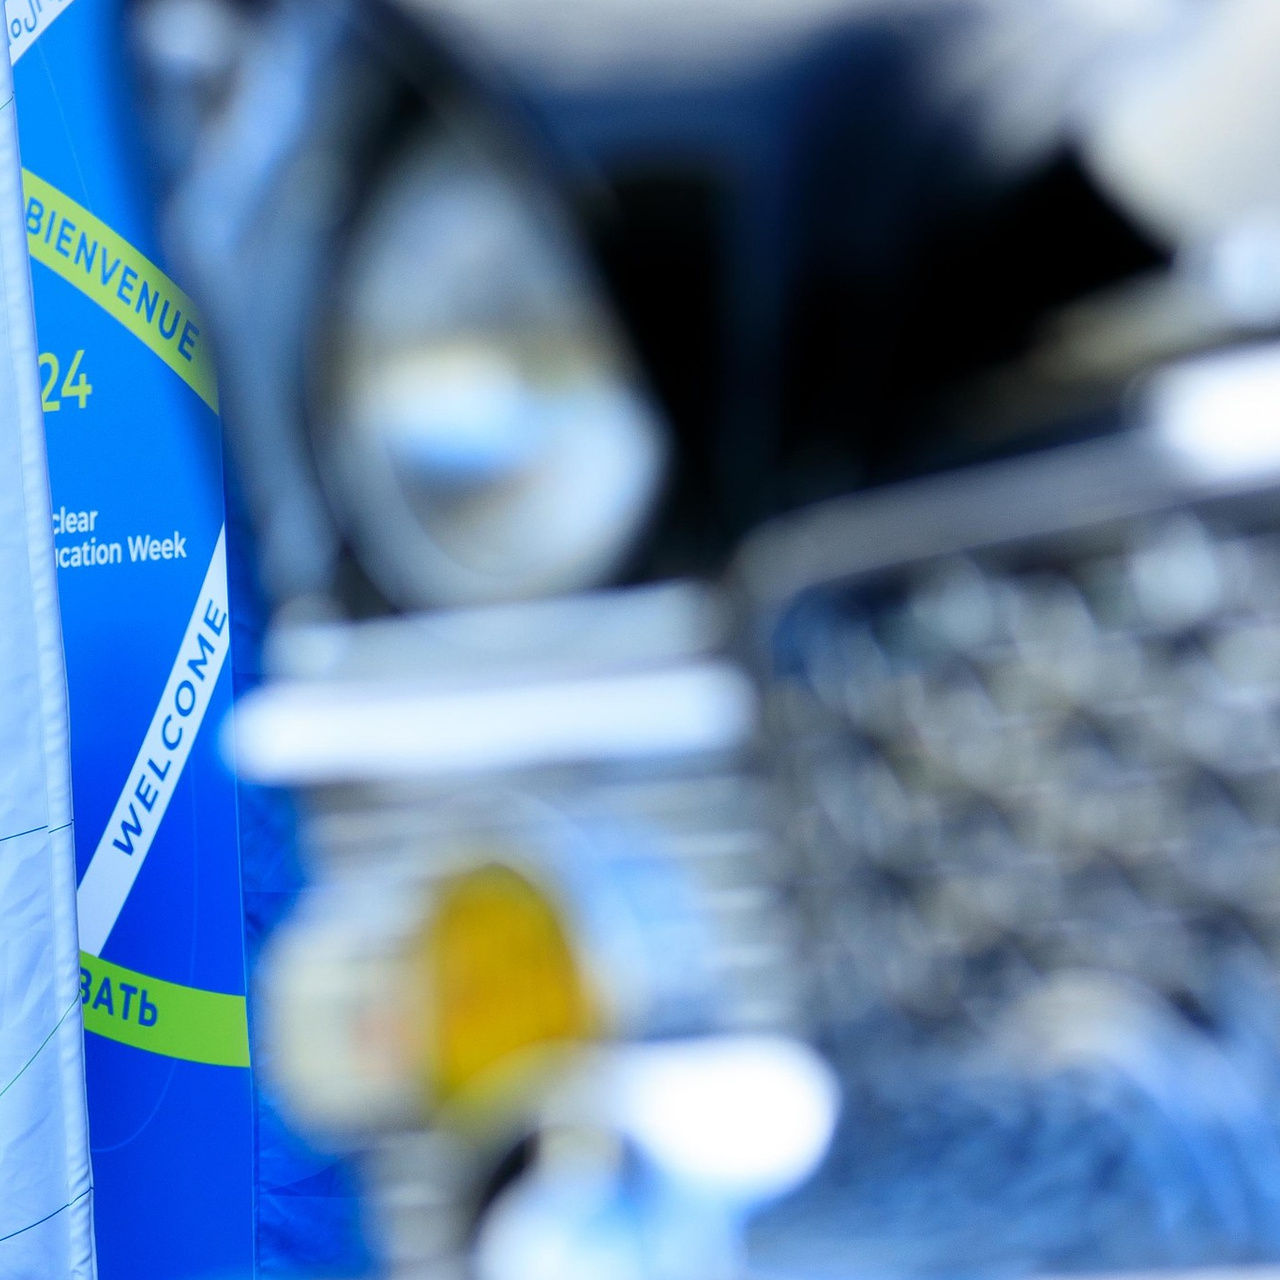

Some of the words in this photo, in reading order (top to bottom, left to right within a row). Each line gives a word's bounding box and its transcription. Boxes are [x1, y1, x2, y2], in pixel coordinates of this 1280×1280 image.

[26, 196, 200, 362] BIENVENUE
[127, 530, 187, 563] Week
[112, 599, 228, 856] WELCOME
